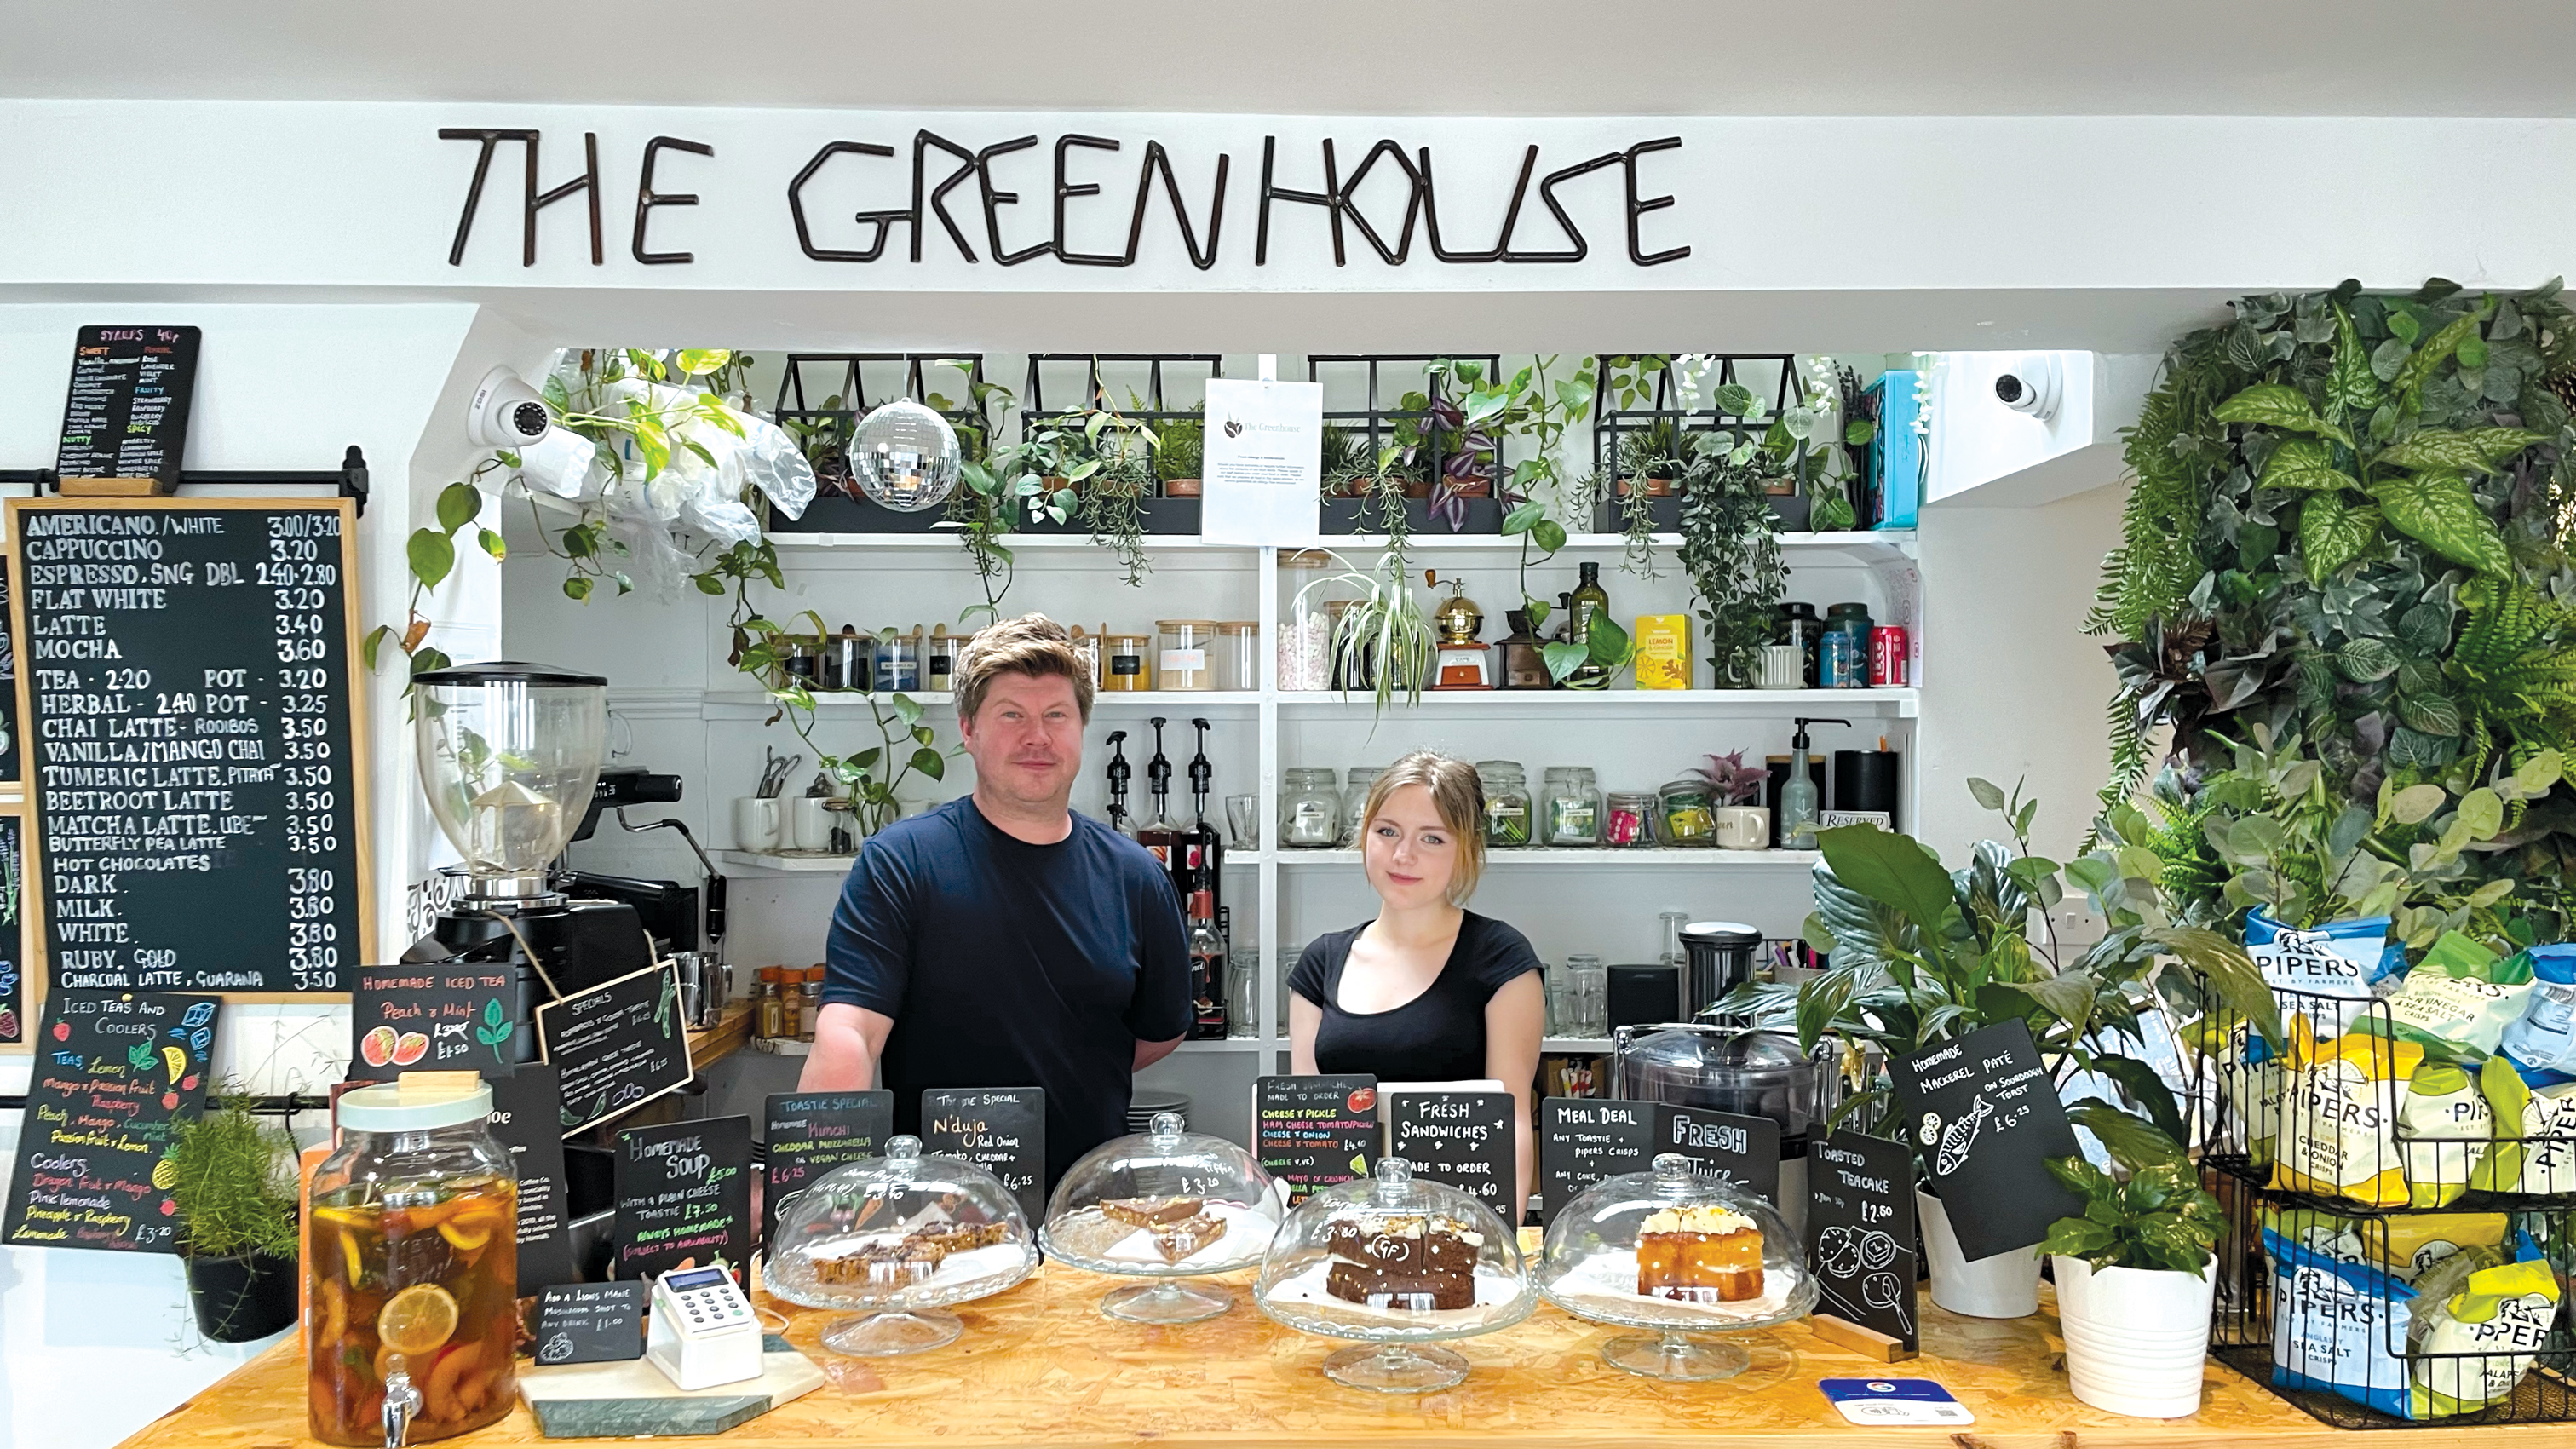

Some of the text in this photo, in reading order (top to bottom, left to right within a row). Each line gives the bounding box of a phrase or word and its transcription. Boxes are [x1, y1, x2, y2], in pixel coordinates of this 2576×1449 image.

[438, 128, 1691, 268] THE GREENHOUSE
[127, 425, 152, 434] SPICY
[1245, 422, 1301, 433] The Greenhouse
[26, 539, 317, 561] CAPPUCCINO 3.20
[205, 562, 244, 585] DBL
[31, 589, 325, 610] FLAT WHITE 3.20
[33, 614, 323, 635] LATTE 3.40
[35, 639, 325, 661] MOCHA 3.60
[36, 669, 81, 690] TEA
[204, 669, 247, 688] POT
[279, 668, 327, 690] 3.20
[41, 694, 131, 714] HERBAL
[205, 694, 250, 714] POT
[281, 694, 328, 714] 3.25
[42, 717, 328, 739] CHAI ROOIBOS 3.50
[227, 739, 265, 761] CHAI
[284, 741, 331, 760] 3.50
[43, 765, 332, 787] TUMERIC 3.50
[46, 791, 335, 811] BEETROOT LATTE 3.50
[47, 814, 334, 835] MATCHA 3.50
[49, 836, 337, 853] BUTTERFLY PEA LATTE 3.50
[53, 855, 211, 873] HOT CHOCOLATES
[2257, 955, 2359, 977] PIPERS
[61, 971, 130, 988] CHARCOAL
[195, 971, 264, 988] GUARANA
[293, 970, 336, 991] 3.50
[363, 975, 506, 990] HOMEMADE ICED TEA
[63, 998, 166, 1015] ICED TEAS AND
[380, 1001, 476, 1020] Peach Mint
[2404, 1002, 2456, 1021] SEA SALT
[2425, 997, 2475, 1022] VINEGAR
[95, 1016, 157, 1041] COOLERS
[1912, 1043, 1963, 1073] HOMEMADE
[1919, 1051, 2014, 1094] MACKEREL PATÉ
[1985, 1066, 2044, 1092] ON SOURDOUGH
[1314, 1091, 1340, 1100] ORDER
[1996, 1084, 2029, 1101] TOAST
[780, 1098, 828, 1112] TOASTIE
[1262, 1108, 1337, 1118] CHEESE PICKLE
[1418, 1101, 1469, 1118] FRESH
[1262, 1120, 1314, 1130] HAM CHEESE
[1557, 1107, 1637, 1126] MEAL DEAL
[934, 1114, 988, 1147] N'duja
[1262, 1130, 1331, 1140] CHEESE ONION
[1400, 1121, 1488, 1141] SANDWICHES
[1553, 1133, 1611, 1143] ANY TOASTIE
[1673, 1114, 1747, 1154] FRESH
[630, 1135, 702, 1162] HOMEMADE
[977, 1135, 993, 1148] Red
[1303, 1140, 1339, 1148] TOMATO
[1575, 1147, 1639, 1159] PIPERS CRISPS
[1812, 1140, 1865, 1168] TOASTED
[666, 1154, 710, 1179] SOUP
[1437, 1161, 1492, 1175] TO ORDER
[1555, 1170, 1571, 1181] ANY
[1287, 1174, 1309, 1184] MAYO
[1837, 1170, 1889, 1194] TEACAKE
